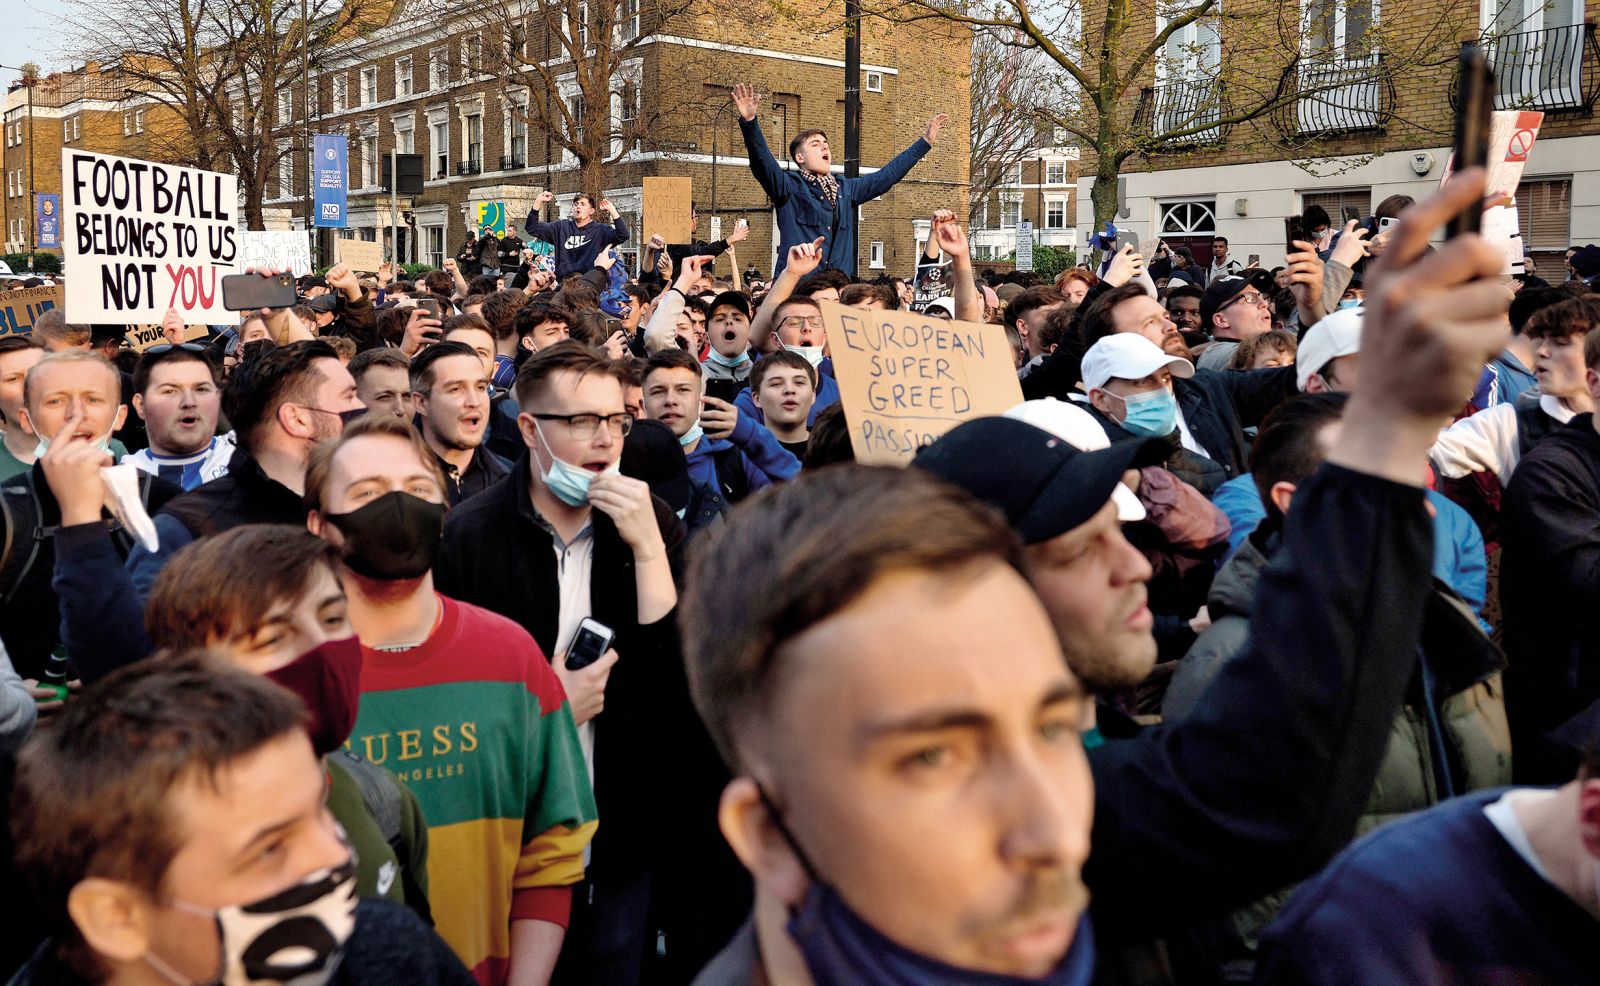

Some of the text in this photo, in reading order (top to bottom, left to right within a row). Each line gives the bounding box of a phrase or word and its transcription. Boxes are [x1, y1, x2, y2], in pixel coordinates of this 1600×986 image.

[72, 154, 229, 221] FOOTBALL
[649, 178, 678, 192] OUR
[323, 205, 339, 213] NO
[645, 194, 683, 210] VOICE
[76, 212, 237, 262] BELONGS TO US
[238, 232, 304, 247] THE CLUB
[287, 244, 307, 258] HAS
[294, 257, 309, 276] US
[101, 262, 216, 311] NOT YOU
[915, 292, 939, 301] EARN
[134, 325, 165, 345] YOUR
[841, 315, 985, 359] EUROPEAN
[870, 355, 954, 380] SUPER
[868, 381, 970, 414] GREED
[344, 721, 478, 766] UESS
[398, 762, 464, 782] NGELES
